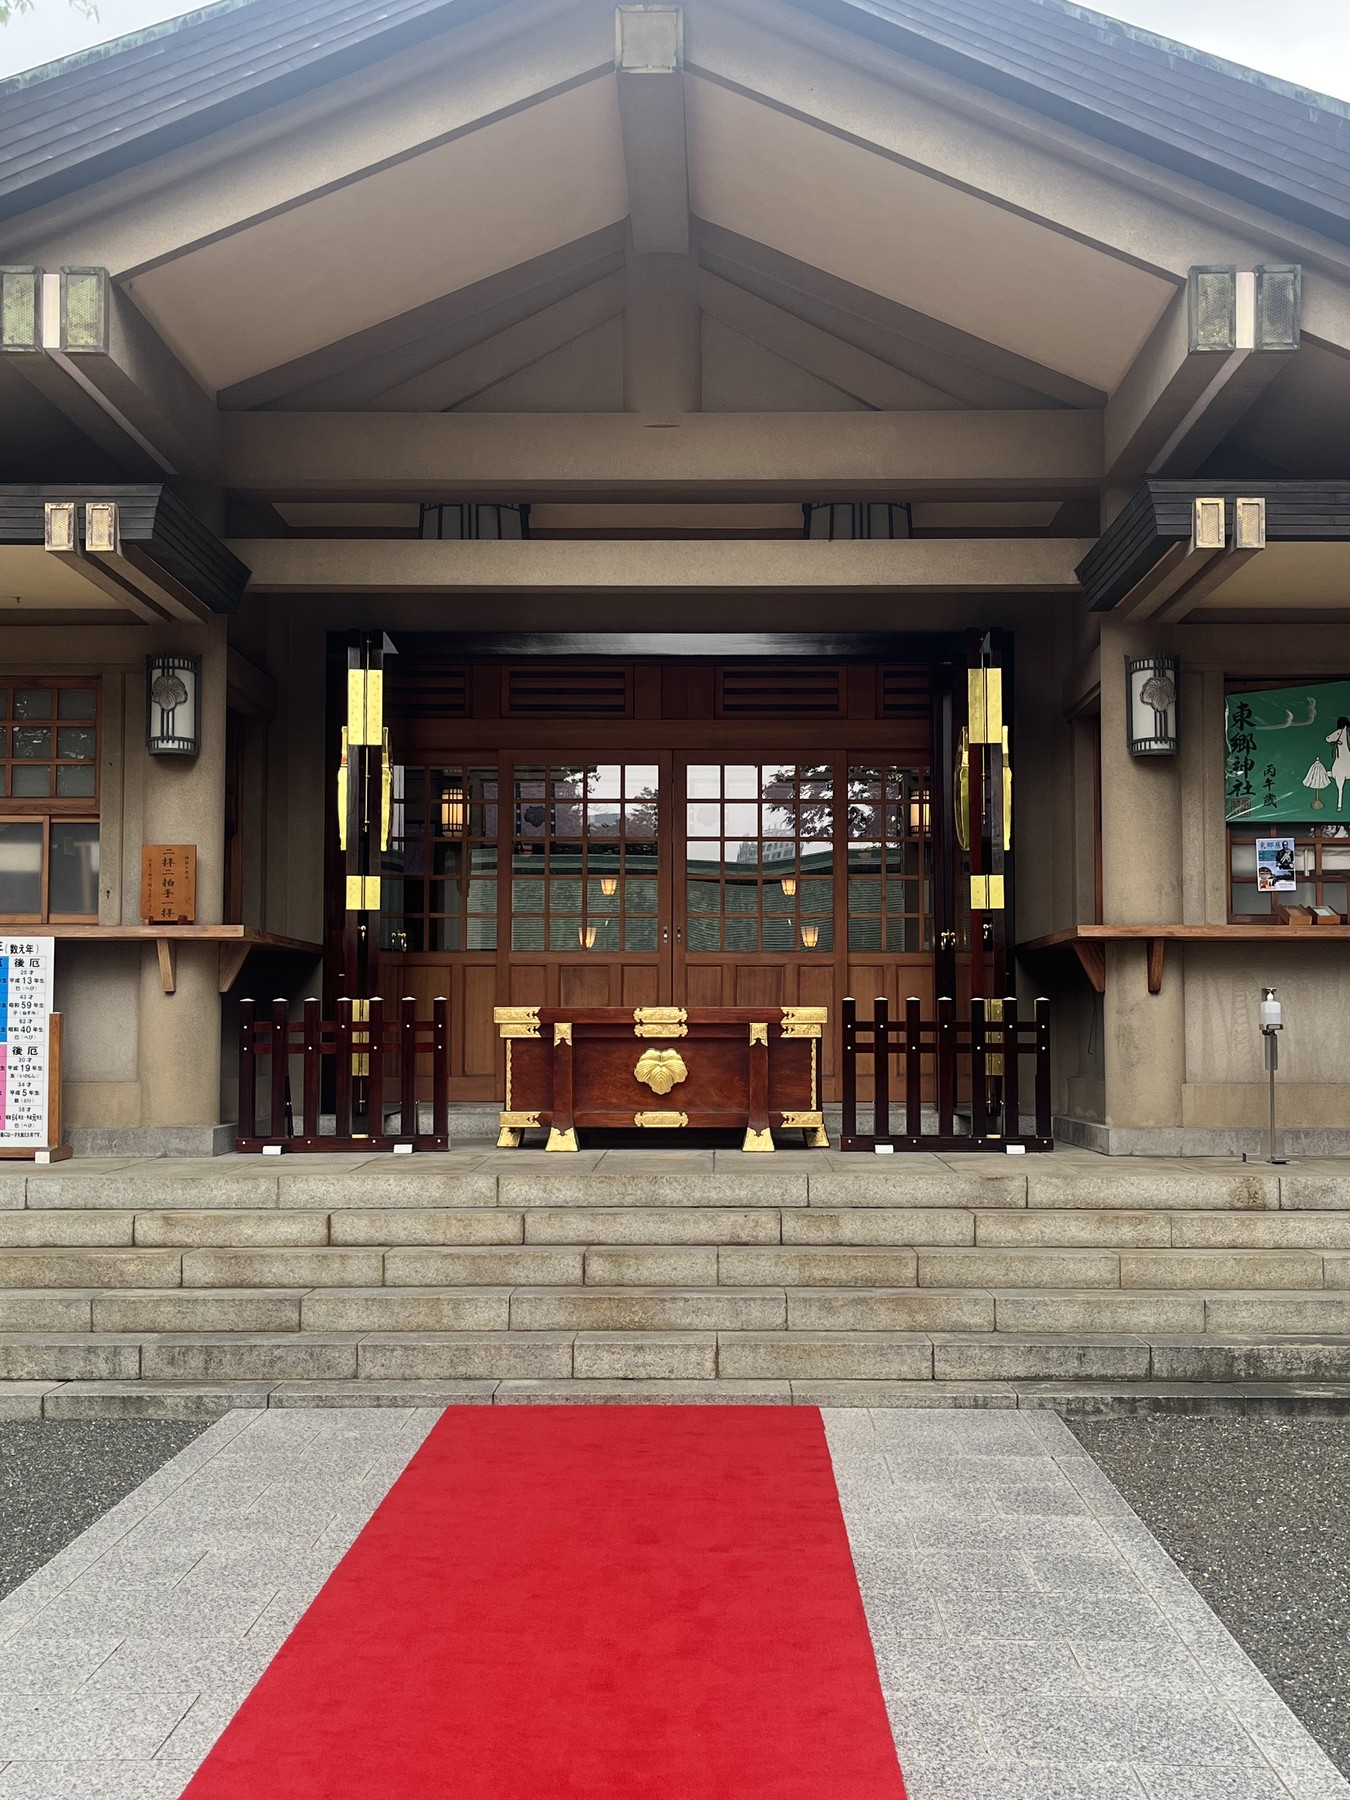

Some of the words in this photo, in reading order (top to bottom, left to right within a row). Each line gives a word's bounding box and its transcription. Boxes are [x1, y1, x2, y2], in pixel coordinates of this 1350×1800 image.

[1228, 702, 1257, 797] 東郷神社
[161, 848, 176, 918] 二拝二拍手一拝
